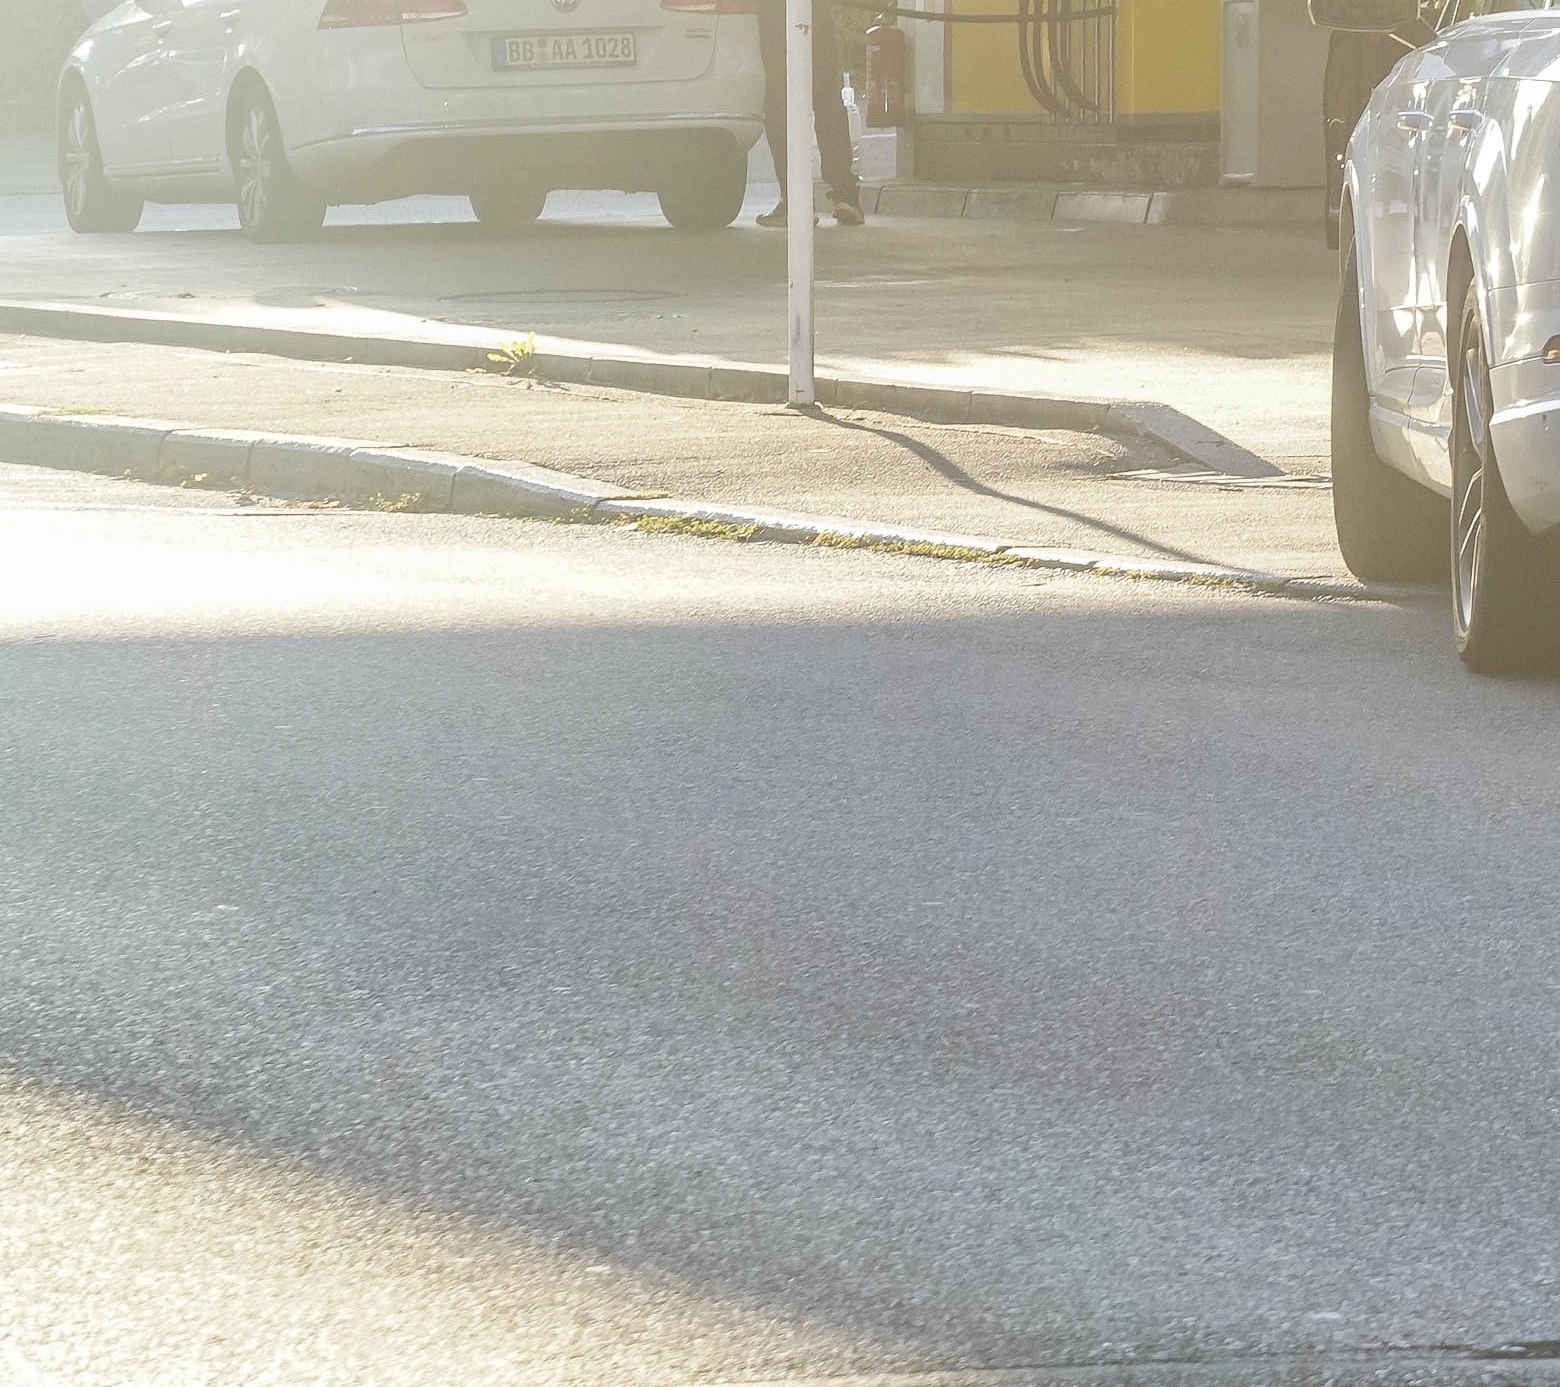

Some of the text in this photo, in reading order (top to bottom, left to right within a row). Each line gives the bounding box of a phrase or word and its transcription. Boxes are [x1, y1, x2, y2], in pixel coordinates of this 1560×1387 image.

[508, 36, 632, 63] BB AA 1028
